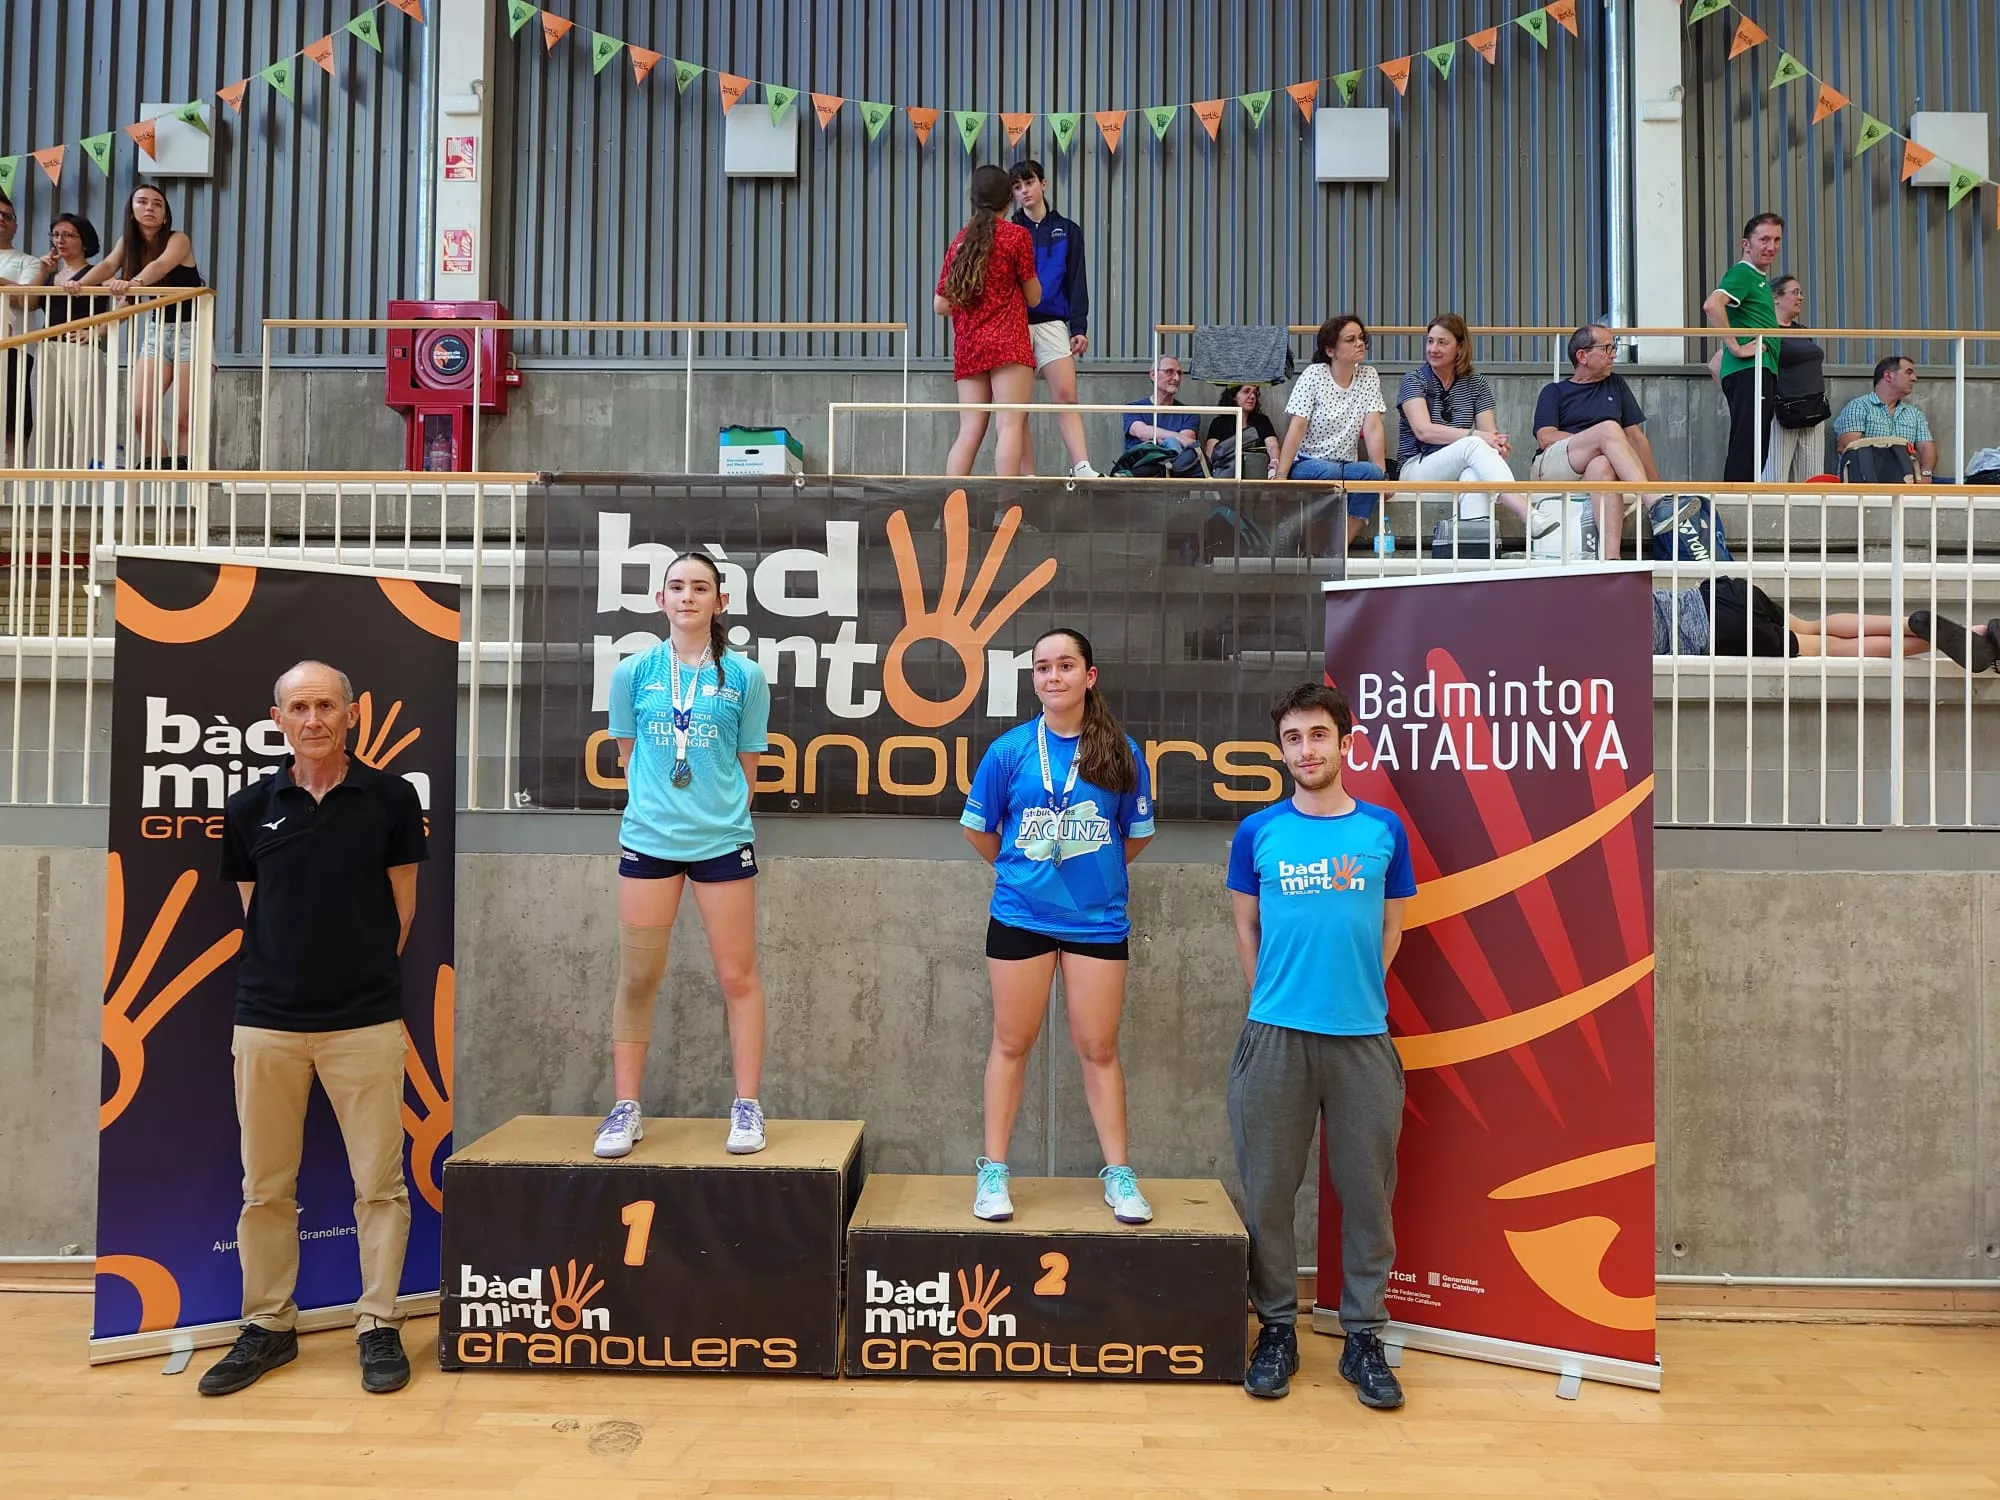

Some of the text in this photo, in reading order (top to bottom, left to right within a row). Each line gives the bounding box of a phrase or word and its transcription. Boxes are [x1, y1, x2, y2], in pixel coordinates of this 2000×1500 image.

[1687, 535, 1711, 561] YON
[1359, 665, 1614, 720] Bàdminton
[1347, 719, 1629, 772] CATALUNYA
[1279, 858, 1328, 877] bàd
[299, 1226, 357, 1241] Granollers
[621, 1200, 655, 1266] 1
[460, 1263, 542, 1299] bàd
[865, 1269, 950, 1304] bàd
[1033, 1252, 1070, 1296] 2
[1388, 1270, 1417, 1283] rtcat
[1442, 1274, 1478, 1286] Generalitat
[1384, 1293, 1406, 1302] portives
[1414, 1297, 1441, 1307] Catalunya
[1442, 1281, 1485, 1294] de Catalunya
